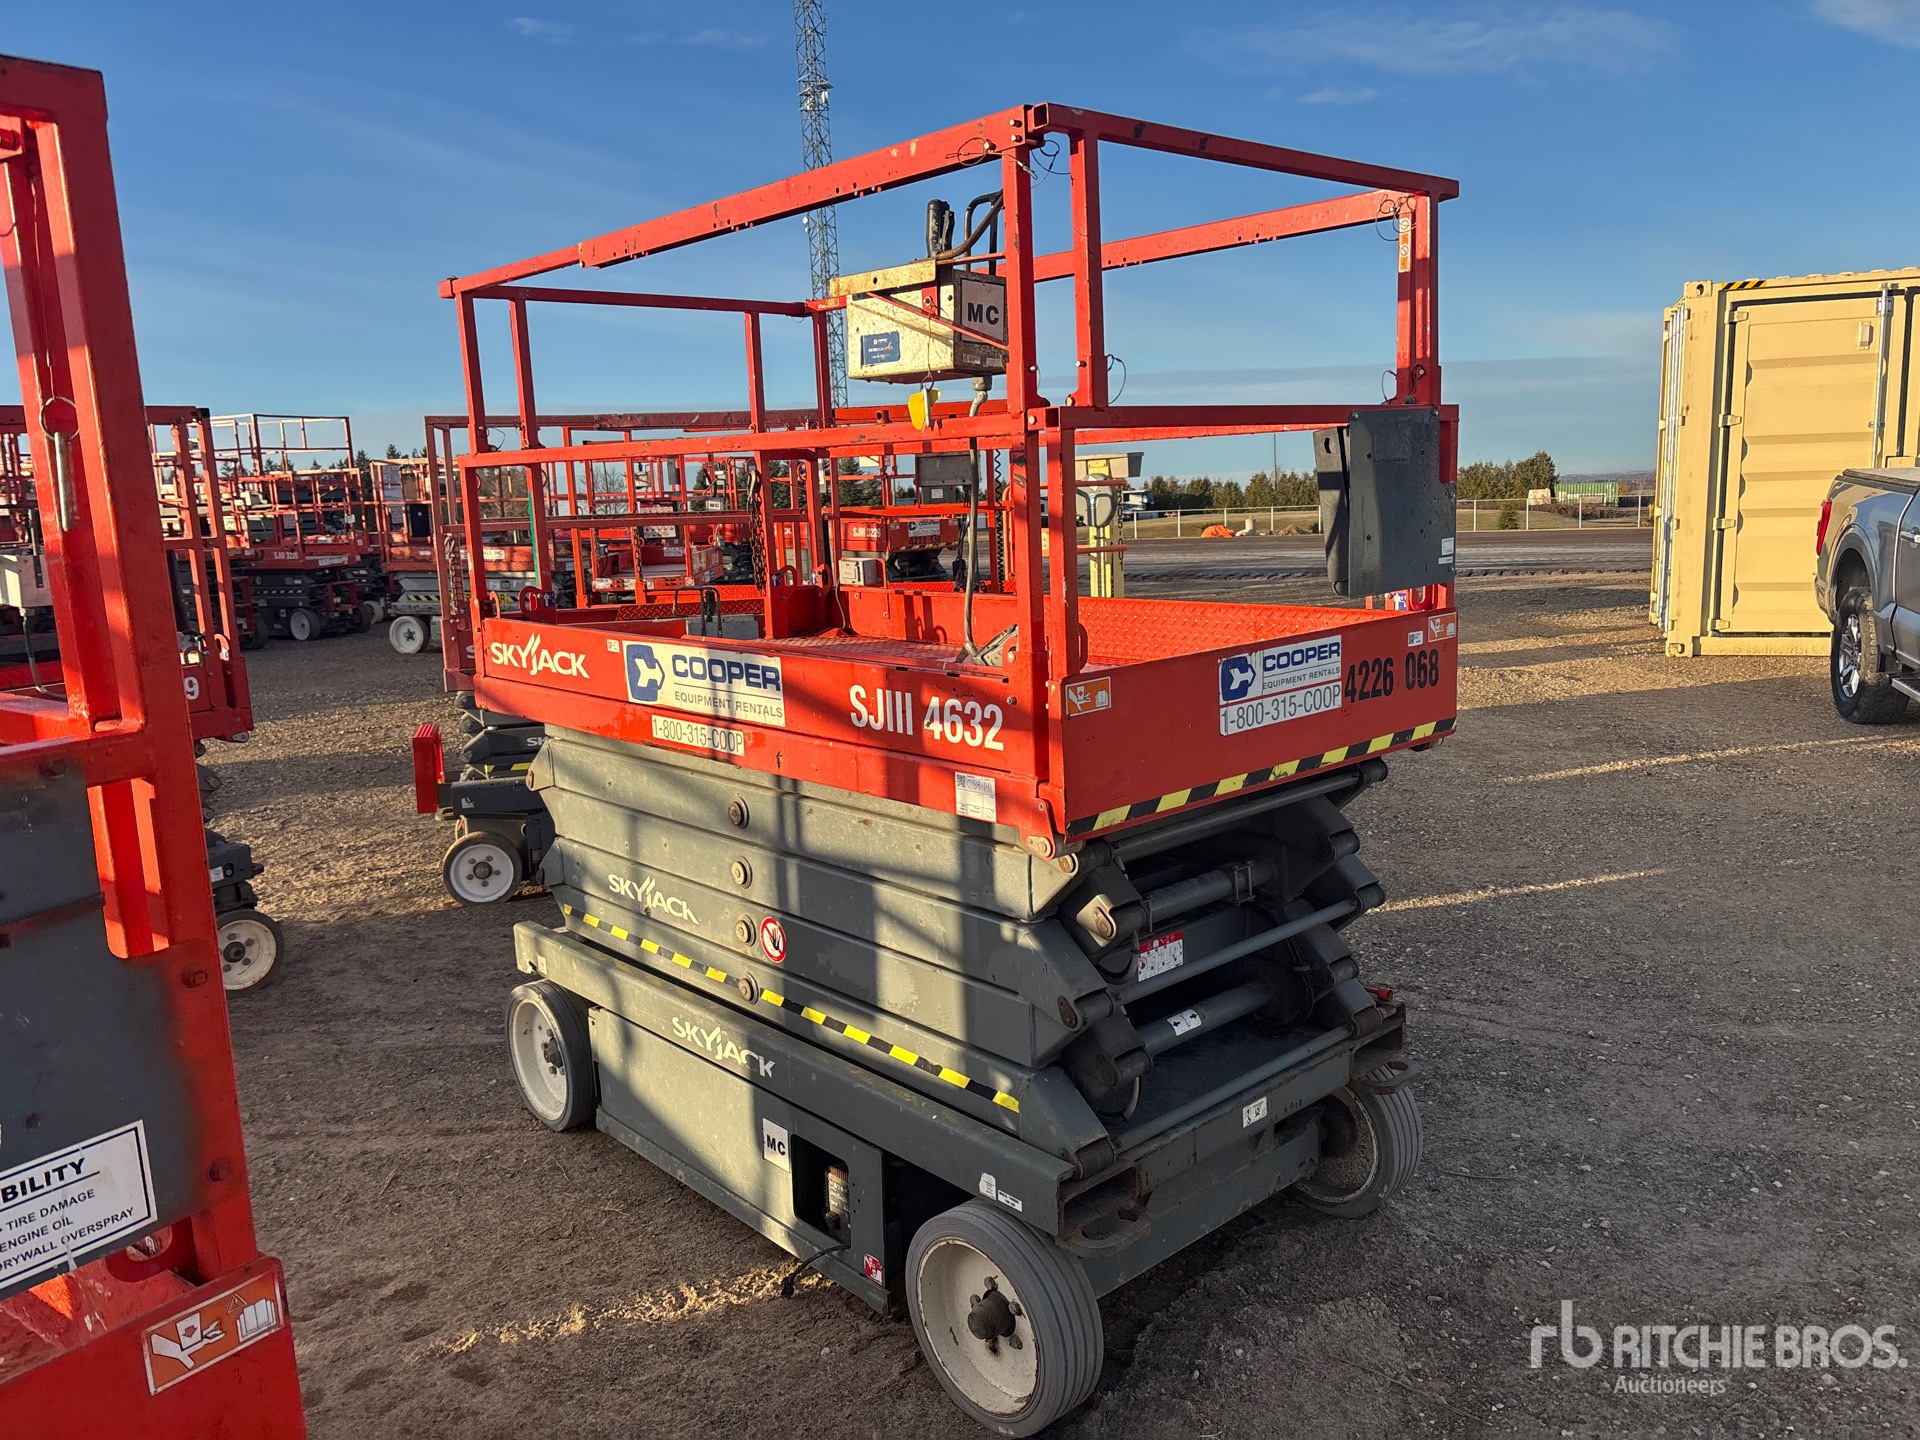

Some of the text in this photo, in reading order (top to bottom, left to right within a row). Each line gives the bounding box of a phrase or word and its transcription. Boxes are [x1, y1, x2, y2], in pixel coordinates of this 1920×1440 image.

[967, 302, 999, 325] MC
[490, 632, 590, 678] SKYJACK
[672, 654, 781, 691] COOPER
[1263, 641, 1340, 672] COOPER
[1263, 666, 1340, 690] EQUIPMENT RENTALS
[1344, 649, 1439, 703] 4226 068
[675, 691, 783, 718] EQUIPMENT RENTALS
[849, 684, 1004, 751] SJIII 4632
[1221, 684, 1341, 729] 1-800-315-COOP
[653, 717, 743, 753] 1-800-315-COOP
[608, 873, 700, 925] SKYJACK
[671, 1016, 775, 1078] SKYJACK
[767, 1134, 786, 1156] MC
[0, 1157, 85, 1204] BILITY
[5, 1188, 95, 1232] TIRE DAMAGE
[60, 1206, 134, 1245] OVERSPRAY
[0, 1216, 74, 1251] ENGINE OIL
